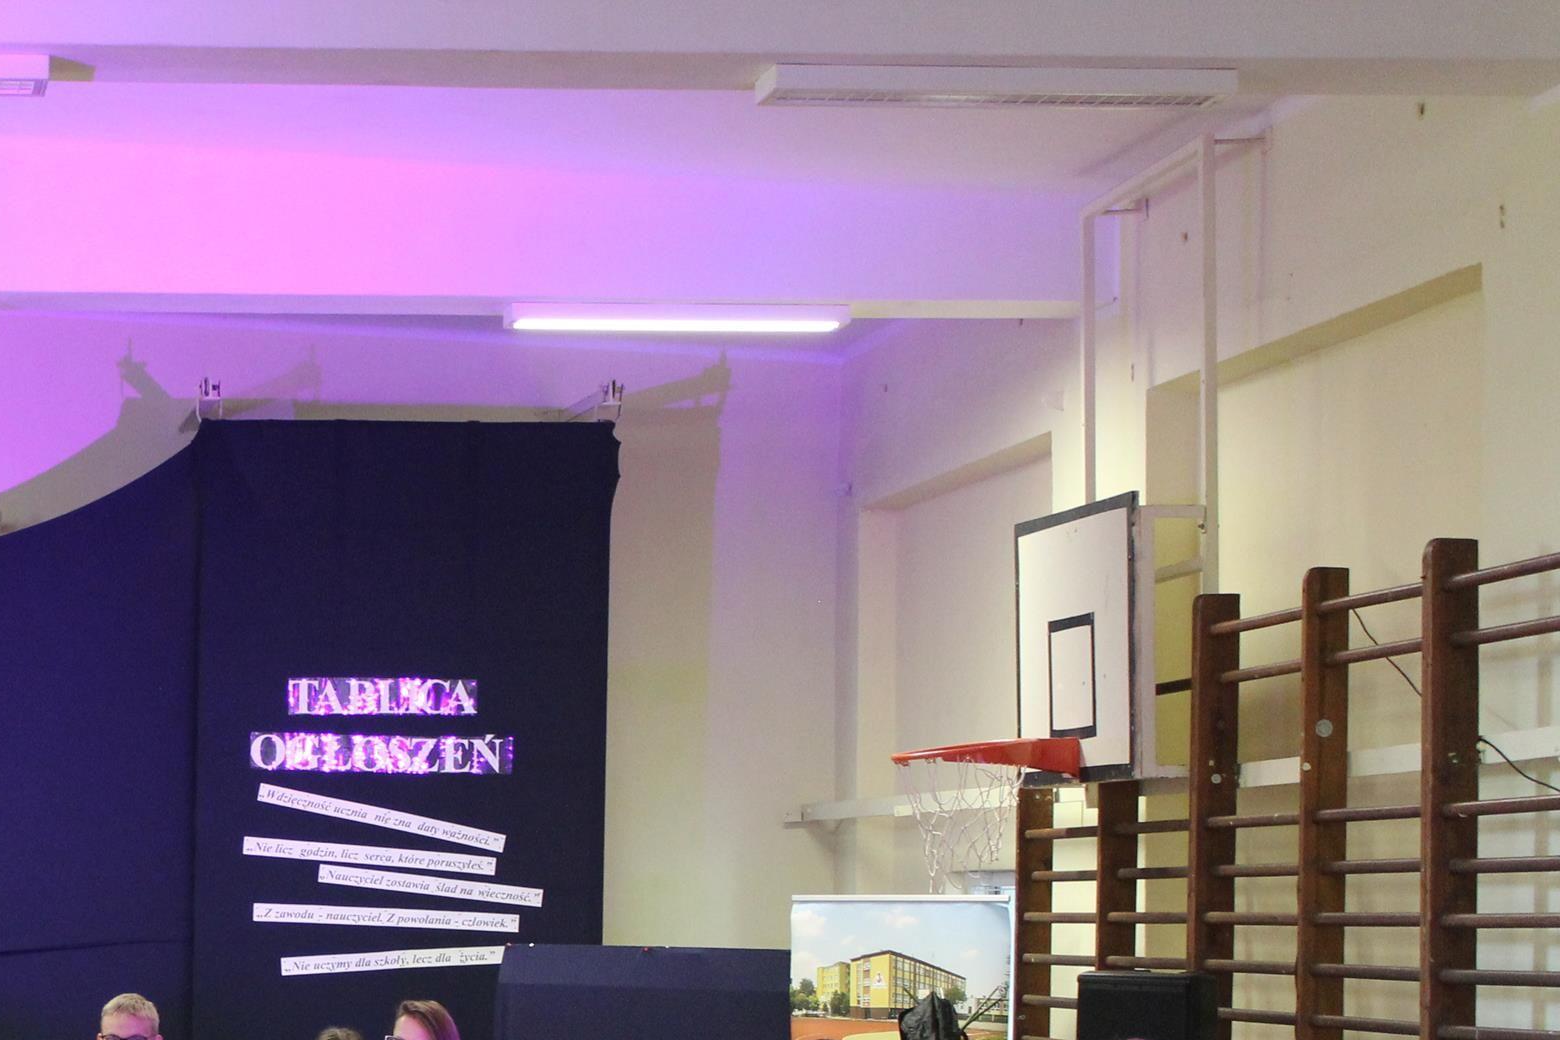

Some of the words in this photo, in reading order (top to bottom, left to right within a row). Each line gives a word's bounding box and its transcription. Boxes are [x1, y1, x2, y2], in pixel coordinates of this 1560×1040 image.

[290, 678, 478, 715] TABLICA
[250, 733, 504, 774] OGŁOSZEŃ
[334, 806, 368, 819] ucznia
[393, 819, 412, 828] zna
[417, 821, 440, 836] daty
[275, 842, 293, 856] licz
[341, 849, 359, 861] licz
[398, 853, 426, 865] które
[386, 878, 430, 891] zostawia
[436, 882, 459, 894] ślad
[460, 887, 474, 896] na
[274, 909, 315, 920] zawodu
[386, 912, 397, 923] Z
[396, 914, 451, 926] powołania
[313, 961, 353, 972] uczymy
[355, 957, 371, 968] dla
[412, 954, 432, 964] lecz
[435, 953, 452, 963] dla
